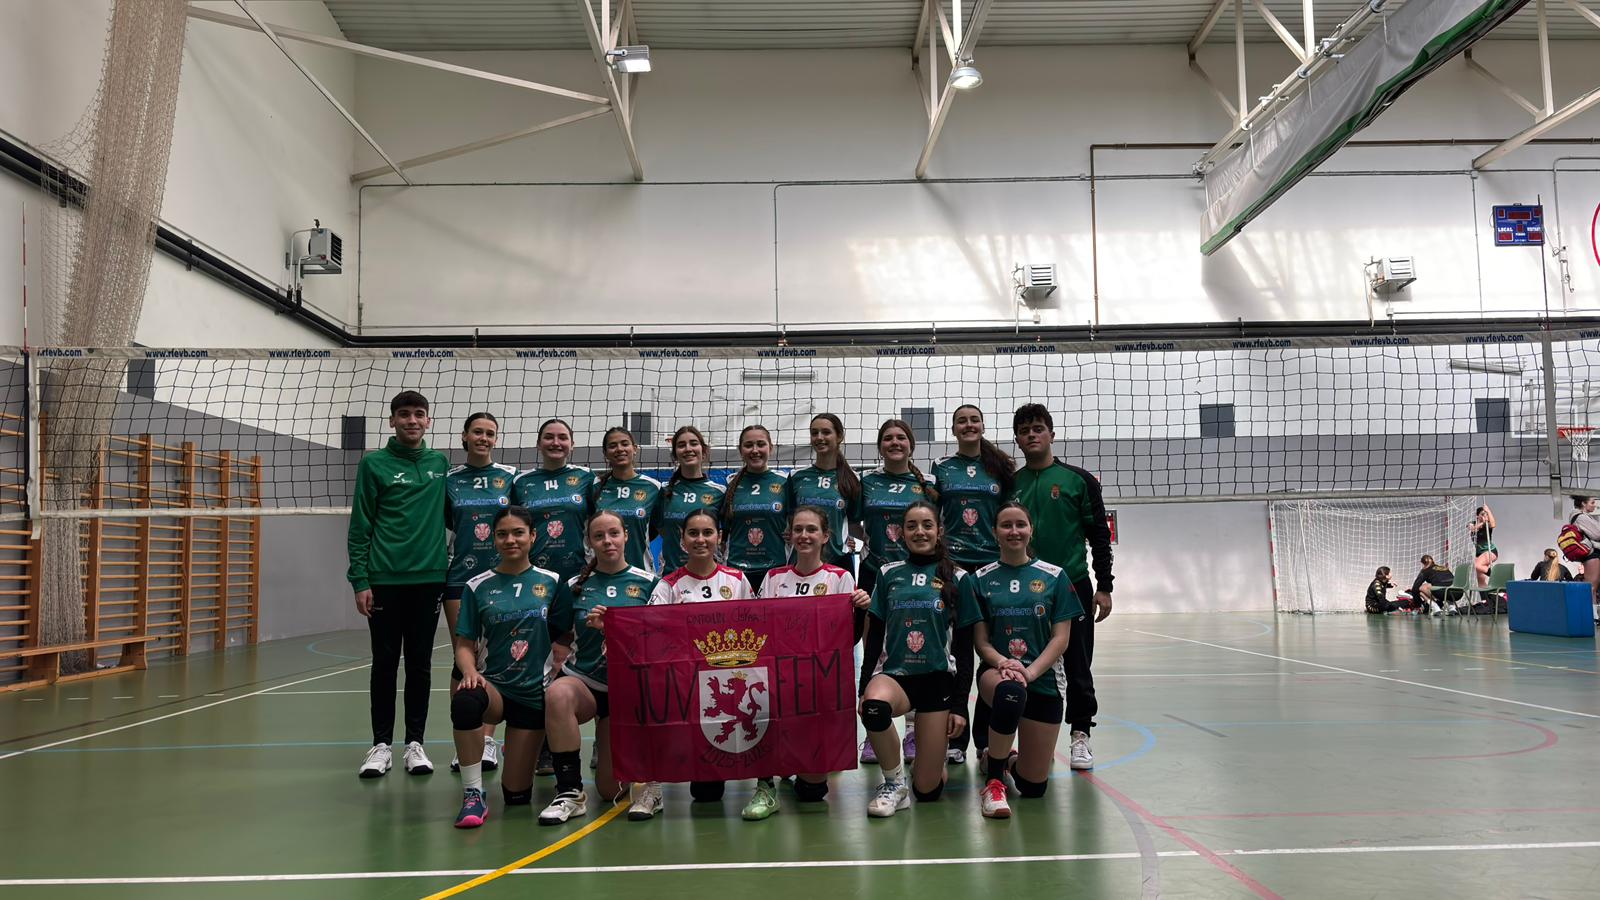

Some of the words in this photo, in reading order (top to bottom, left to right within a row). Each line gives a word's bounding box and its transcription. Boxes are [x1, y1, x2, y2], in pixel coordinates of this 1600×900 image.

[1233, 339, 1291, 349] www.rfevb.com
[1351, 336, 1409, 346] www.rfevb.com
[1465, 333, 1524, 343] www.rfevb.com
[757, 347, 816, 357] www.rfevb.com
[877, 346, 935, 355] www.rfevb.com
[996, 344, 1055, 354] www.rfevb.com
[1115, 342, 1174, 351] www.rfevb.com
[145, 348, 208, 358] www.rfevb.com
[269, 348, 331, 358] www.rfevb.com
[392, 348, 454, 358] www.rfevb.com
[516, 348, 577, 358] www.rfevb.com
[639, 348, 699, 358] www.rfevb.com
[966, 465, 977, 478] 5
[473, 476, 488, 489] 21
[544, 479, 559, 491] 14
[818, 476, 831, 489] 16
[888, 483, 906, 494] 27
[616, 486, 630, 499] 19
[750, 483, 761, 496] 2
[683, 492, 697, 504] 13
[911, 573, 927, 587] 18
[1009, 579, 1021, 593] 8
[512, 583, 523, 598] 7
[606, 585, 618, 598] 6
[701, 585, 712, 599] 3
[795, 582, 810, 595] 10
[629, 663, 699, 726] JUV
[775, 648, 842, 720] FEM
